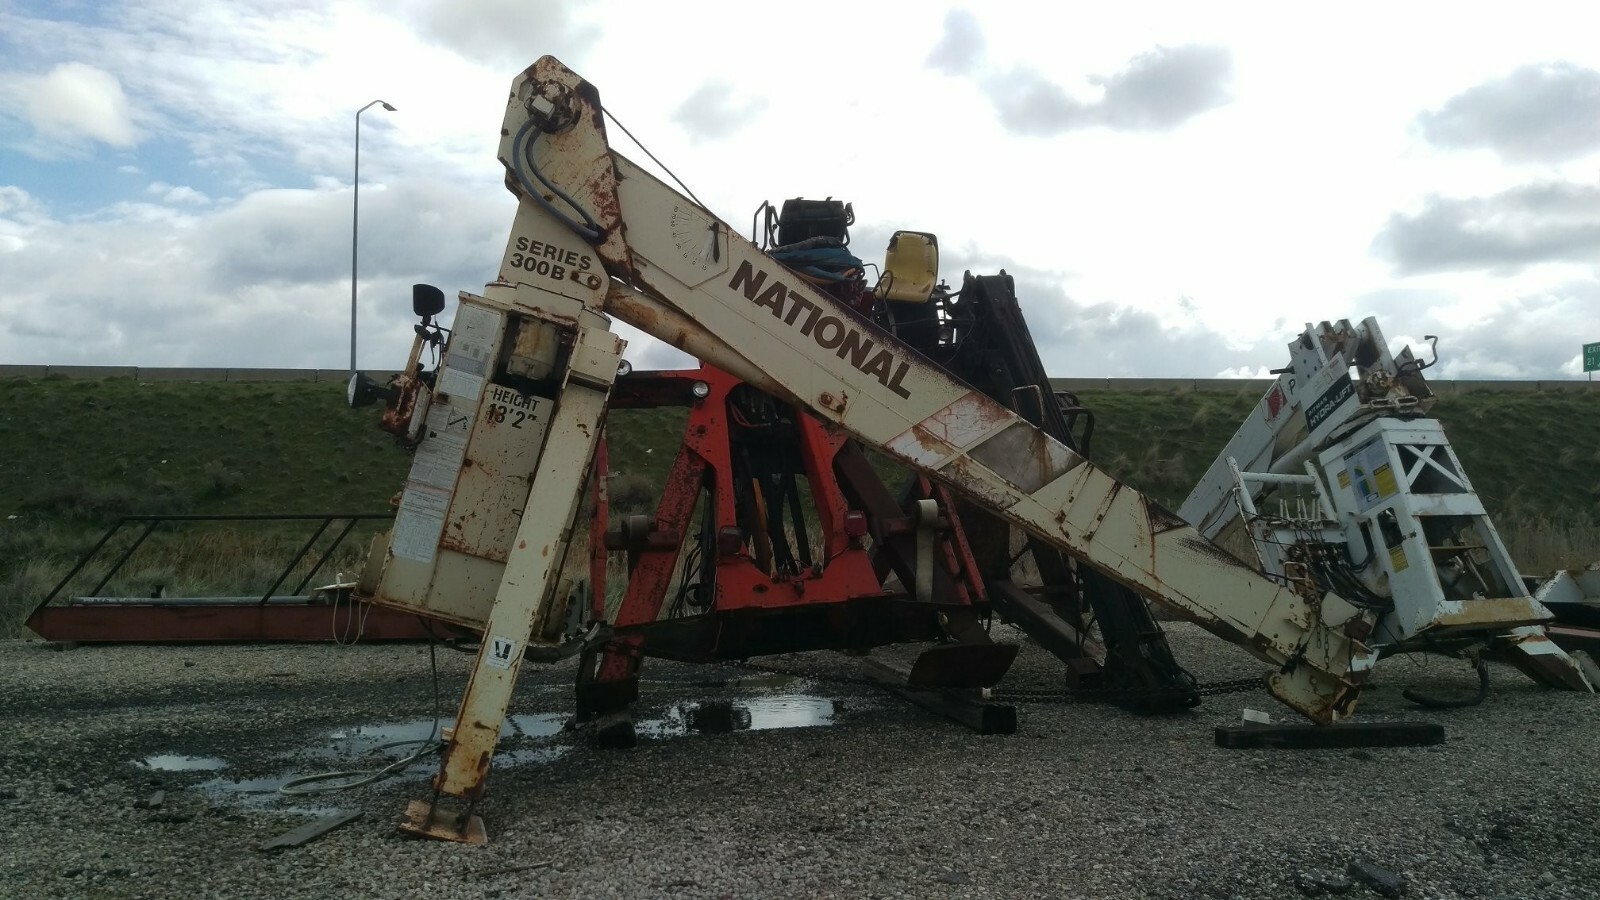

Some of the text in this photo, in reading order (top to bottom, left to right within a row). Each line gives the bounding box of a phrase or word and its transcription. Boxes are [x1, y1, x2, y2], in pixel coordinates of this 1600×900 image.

[510, 252, 566, 281] 300B
[515, 236, 592, 270] SERIES
[728, 259, 911, 400] NATIONAL
[493, 387, 540, 411] HEIGHT
